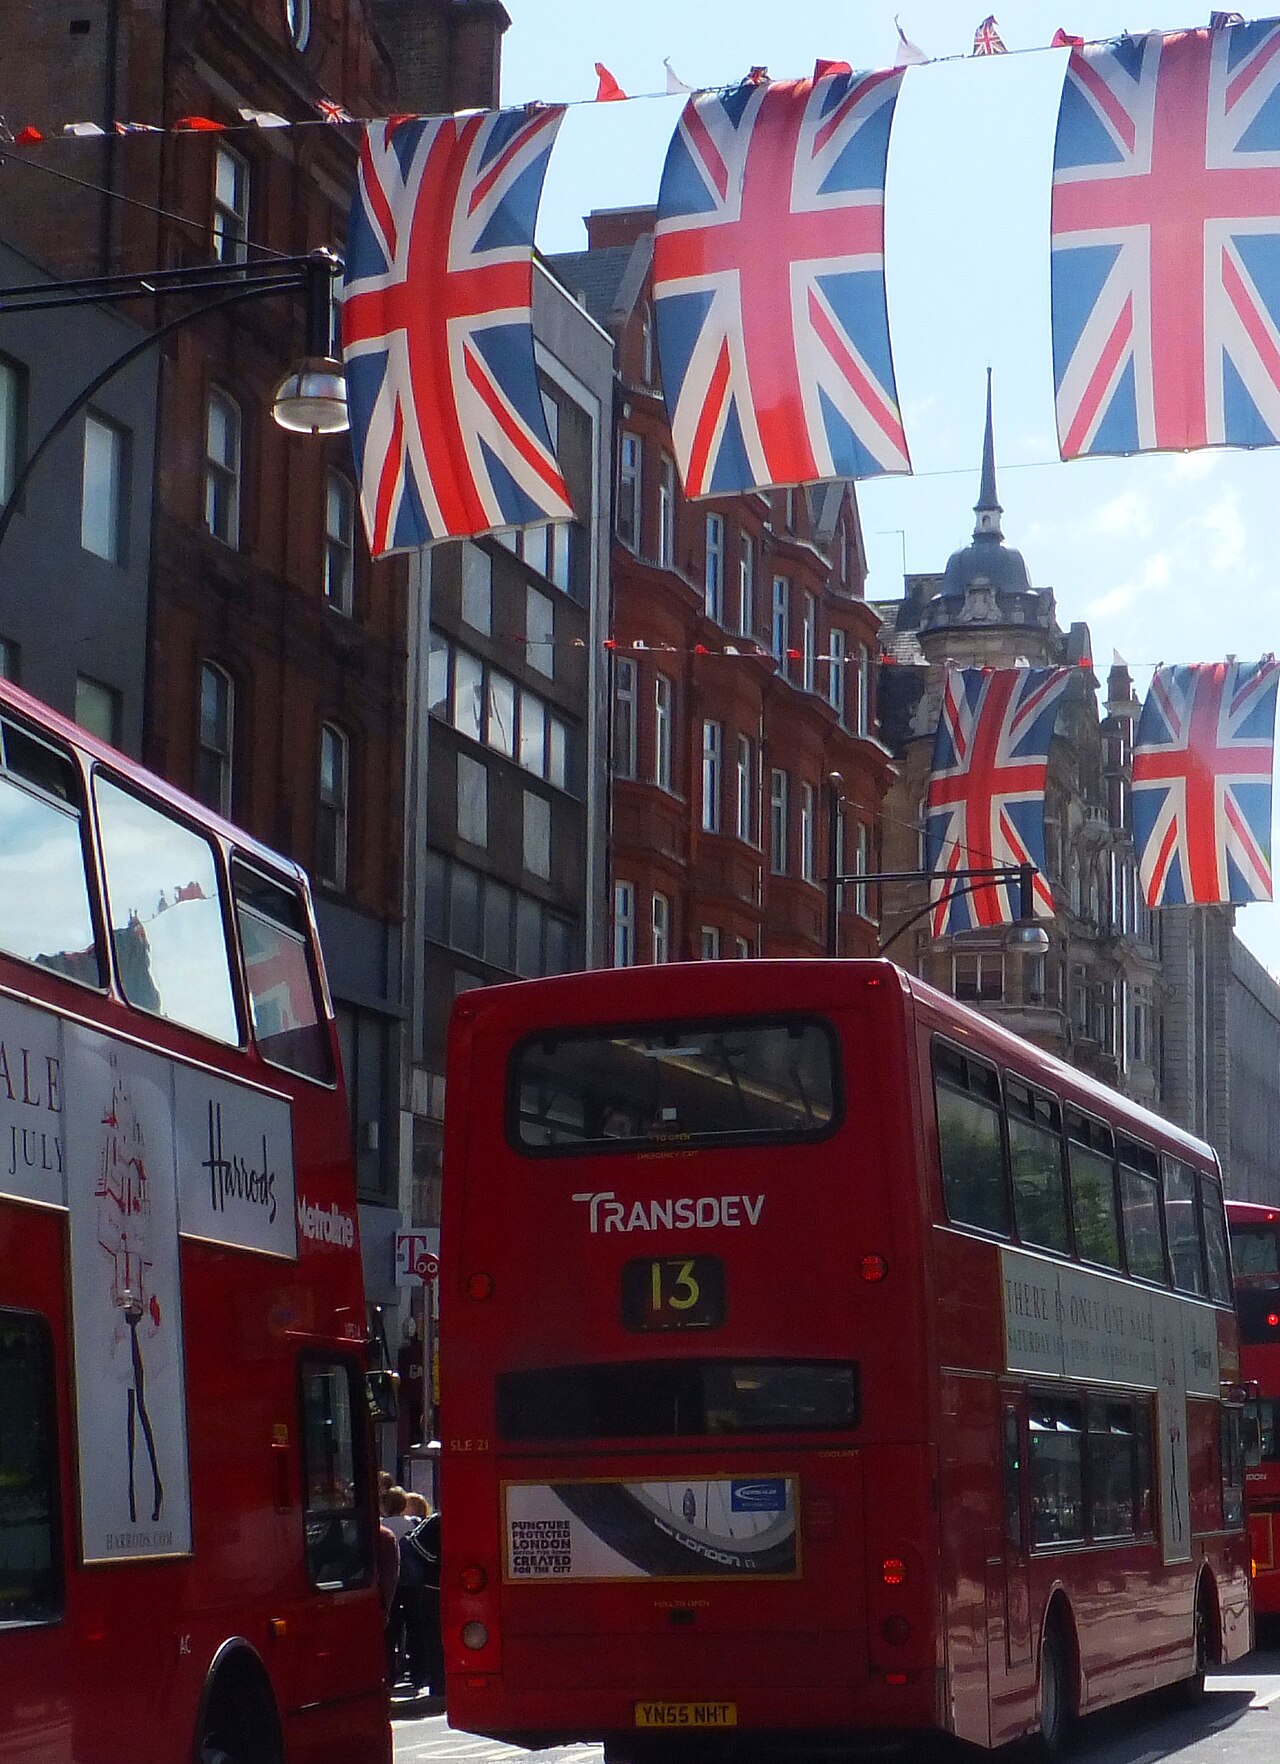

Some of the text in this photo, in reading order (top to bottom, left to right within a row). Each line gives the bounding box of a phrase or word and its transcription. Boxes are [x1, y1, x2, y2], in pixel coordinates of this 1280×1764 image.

[9, 1126, 64, 1175] JULY
[202, 1100, 276, 1224] Harrods
[572, 1191, 765, 1233] TRANSDEV
[651, 1259, 700, 1310] 13
[1006, 1279, 1049, 1321] THERE
[512, 1520, 570, 1530] PUNCTURE
[512, 1530, 570, 1539] PROTECTED
[512, 1539, 571, 1550] LONDON
[513, 1555, 571, 1566] CREATED
[553, 1565, 571, 1573] CITY
[643, 1705, 730, 1724] YN55 NHT
